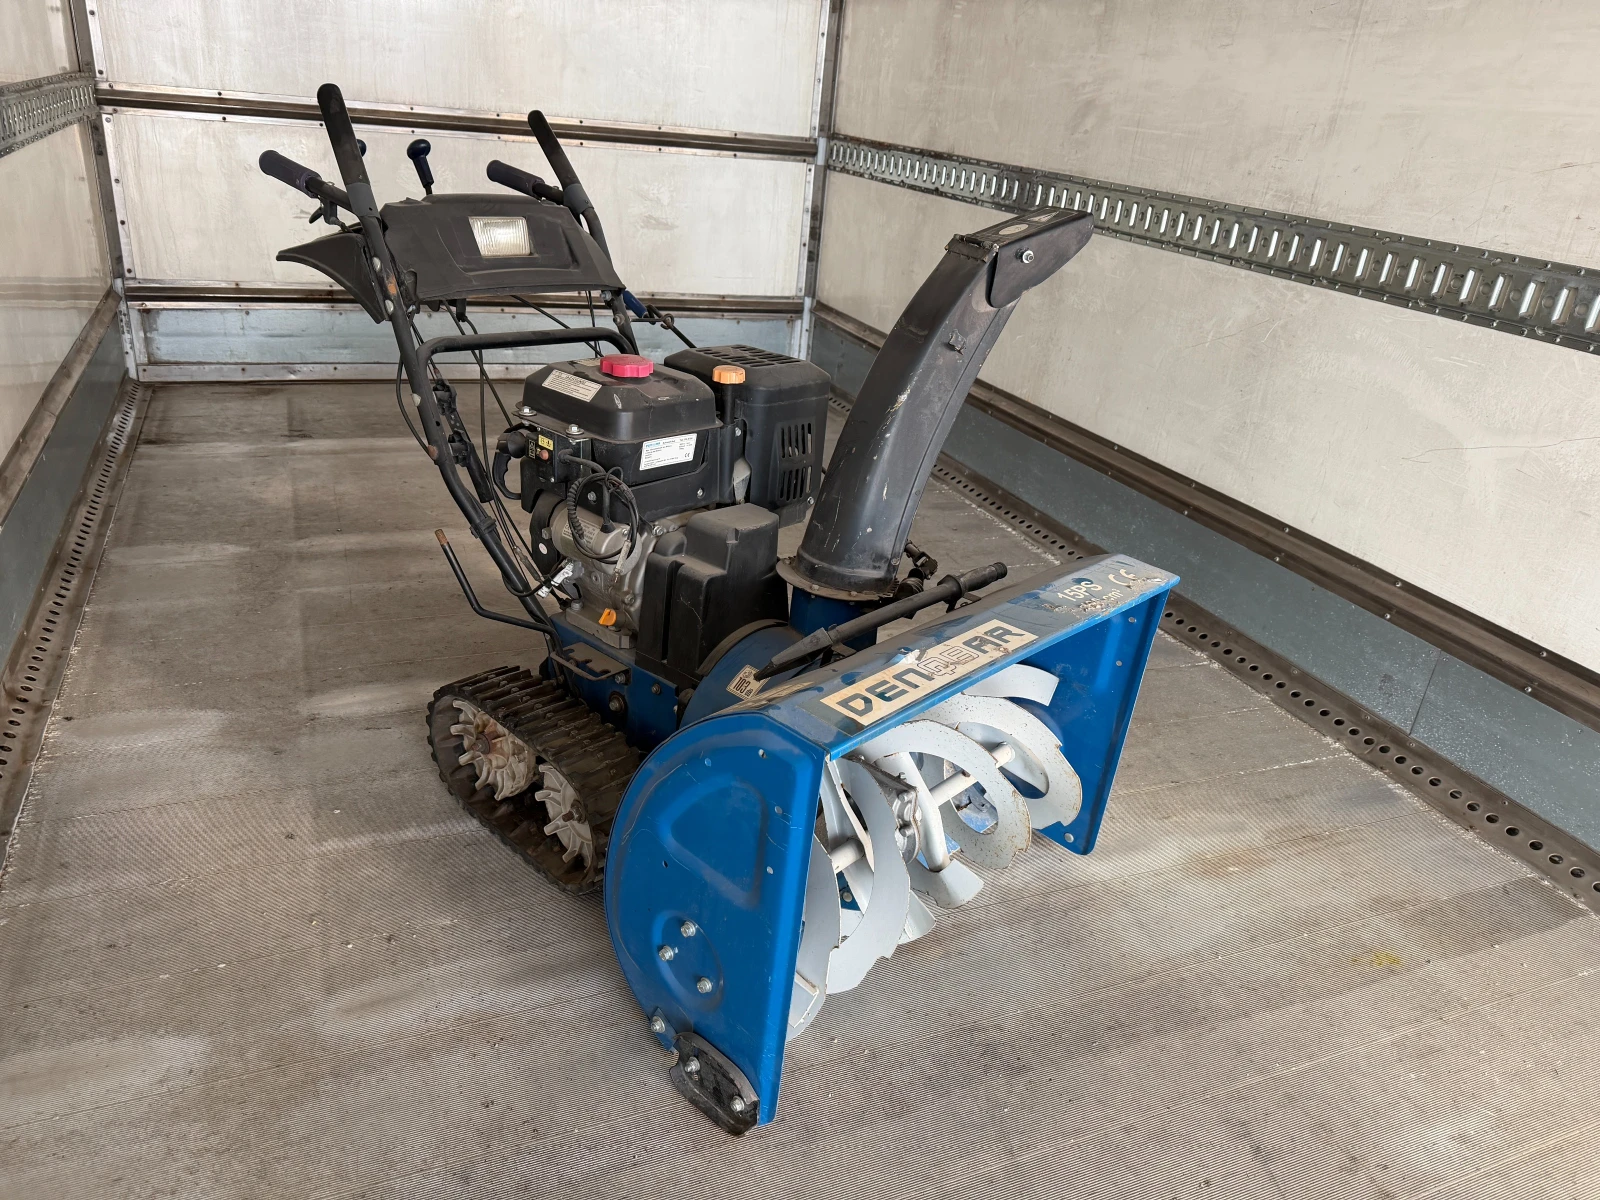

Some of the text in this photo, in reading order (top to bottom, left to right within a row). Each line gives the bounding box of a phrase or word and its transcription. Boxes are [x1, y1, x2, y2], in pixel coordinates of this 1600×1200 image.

[1057, 581, 1103, 602] 15PS
[836, 626, 1025, 717] DENQBAR
[733, 676, 751, 694] 103
